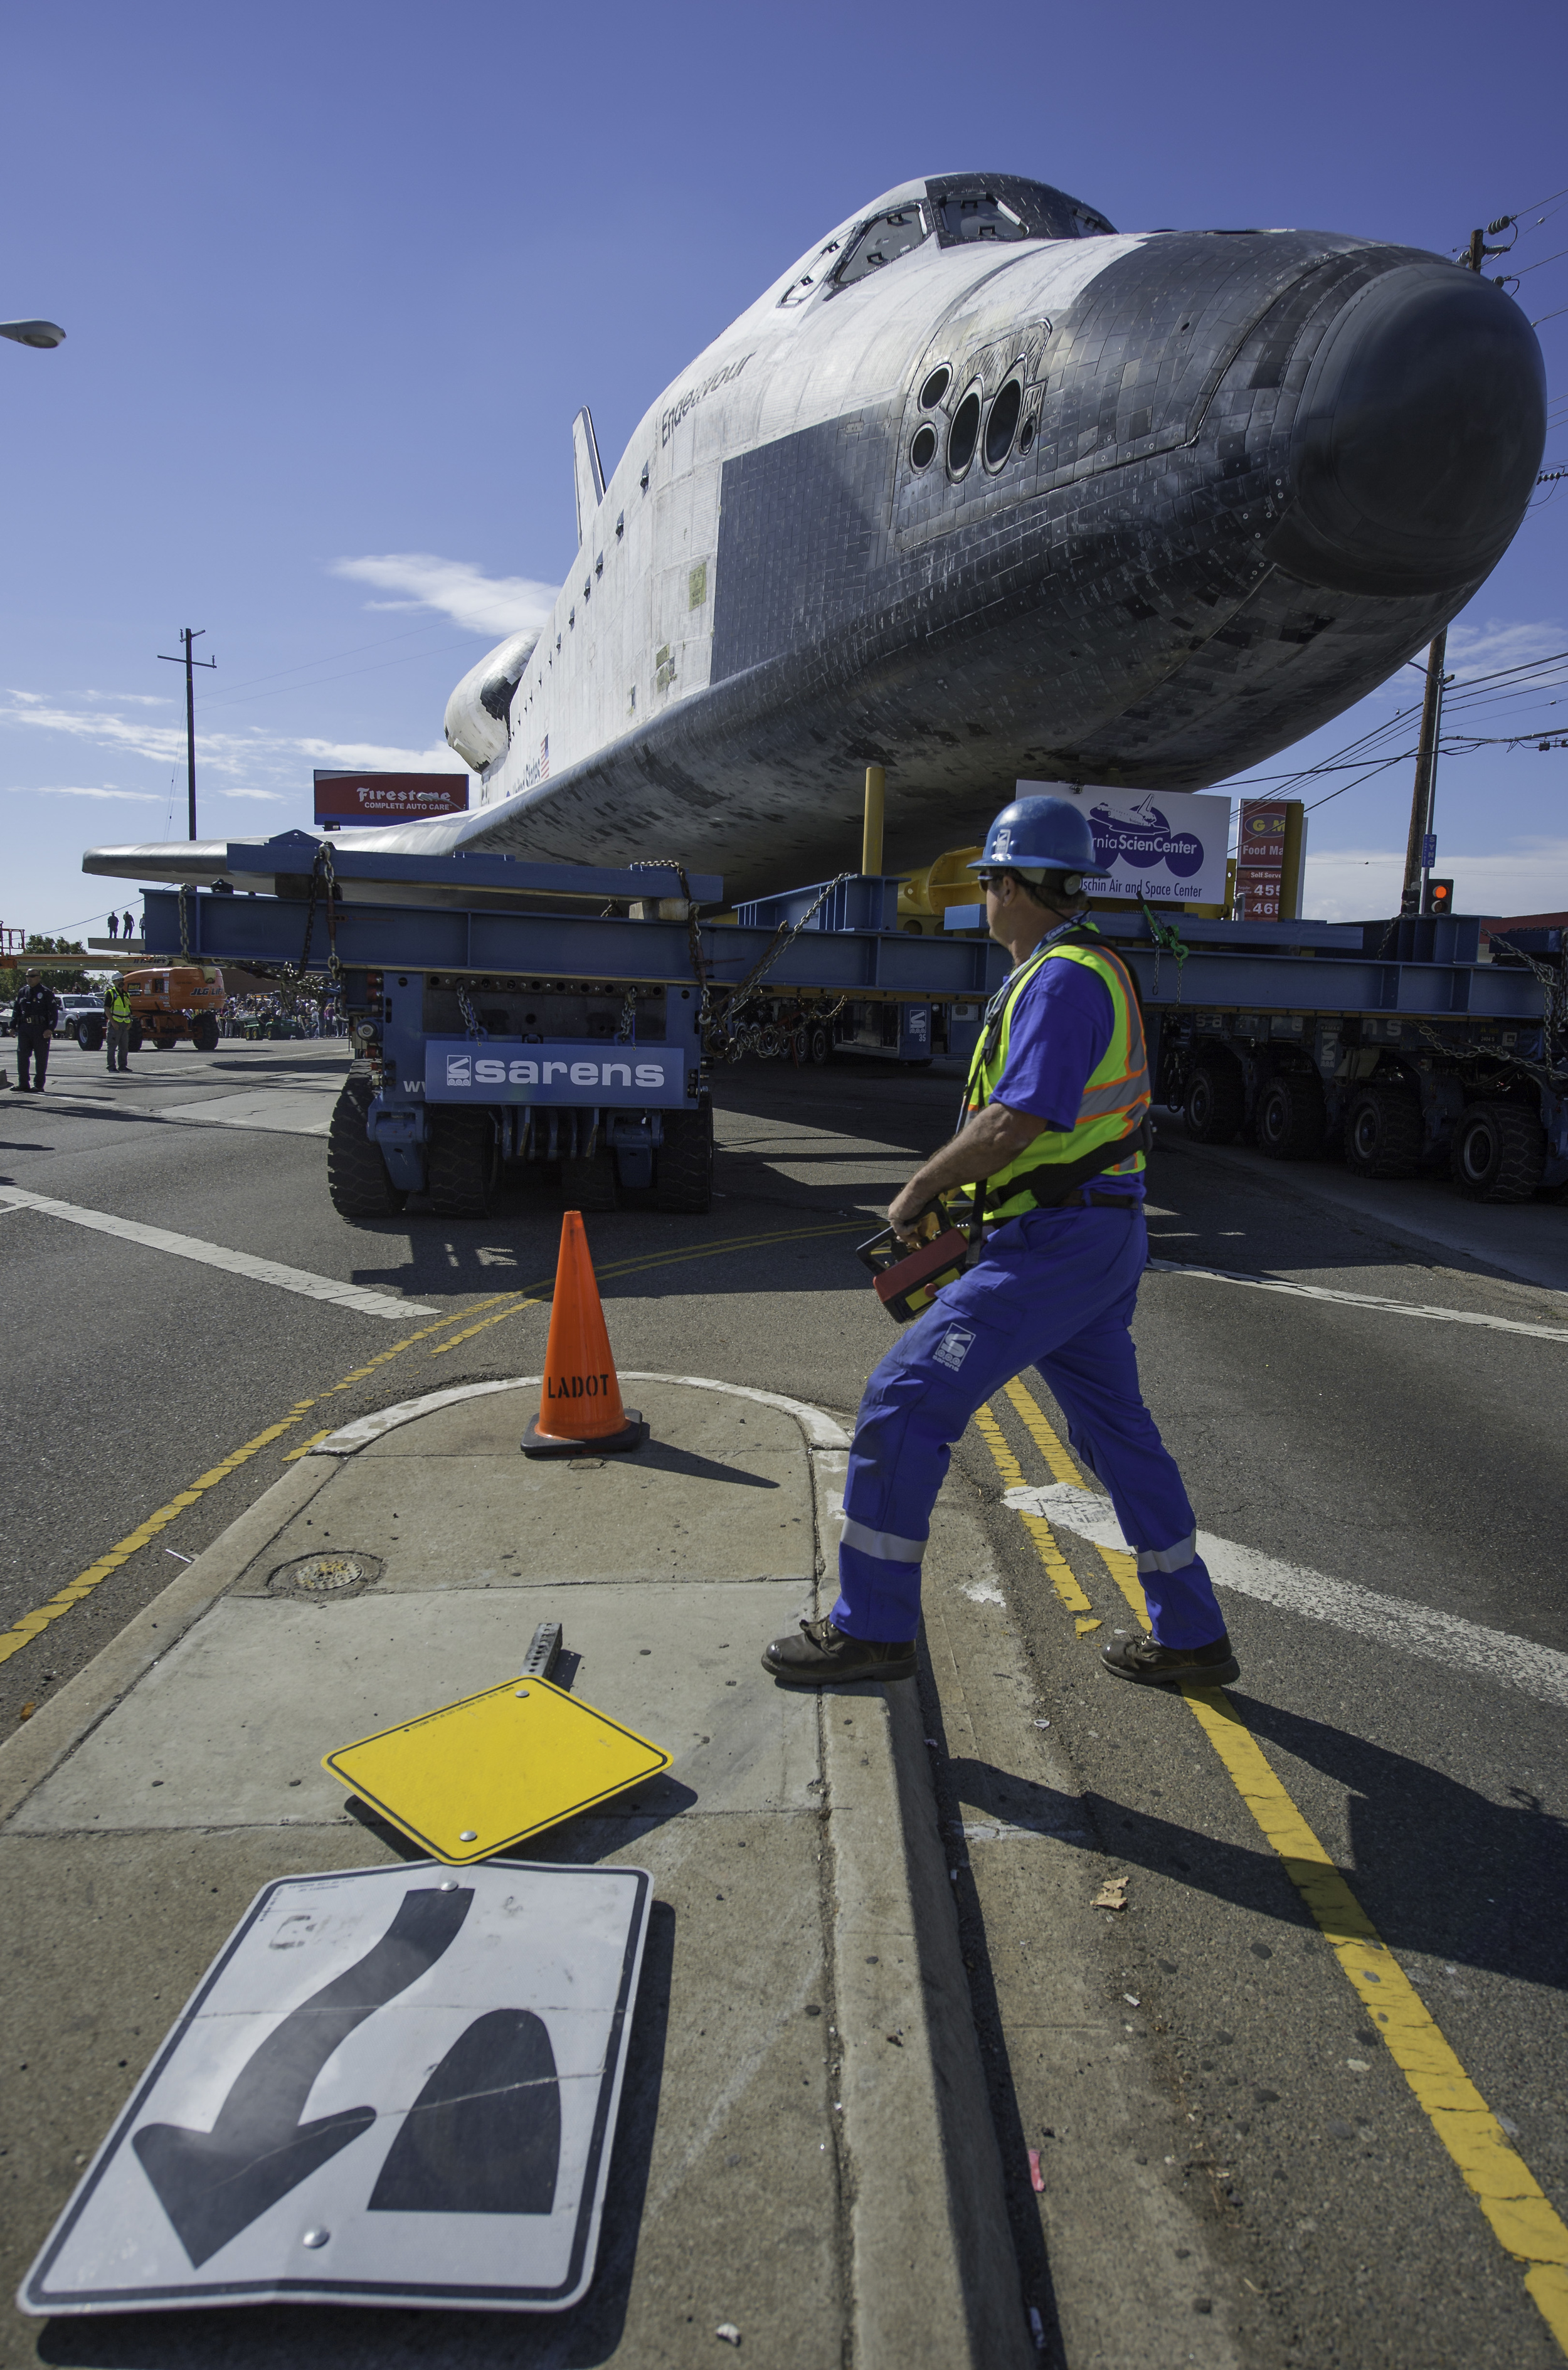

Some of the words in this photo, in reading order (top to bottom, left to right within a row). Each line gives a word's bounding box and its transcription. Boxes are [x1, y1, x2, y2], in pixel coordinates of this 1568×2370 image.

[1242, 845, 1266, 855] Food
[1269, 845, 1283, 855] Ma
[1427, 836, 1436, 865] SYNC
[1109, 878, 1123, 893] Air
[1125, 879, 1143, 894] and
[1145, 881, 1171, 897] Space
[1174, 882, 1202, 897] Center
[189, 987, 209, 996] JLG
[919, 1034, 926, 1042] 35
[474, 1059, 665, 1088] sarens
[932, 1355, 960, 1372] sarens
[548, 1374, 609, 1399] LADOT
